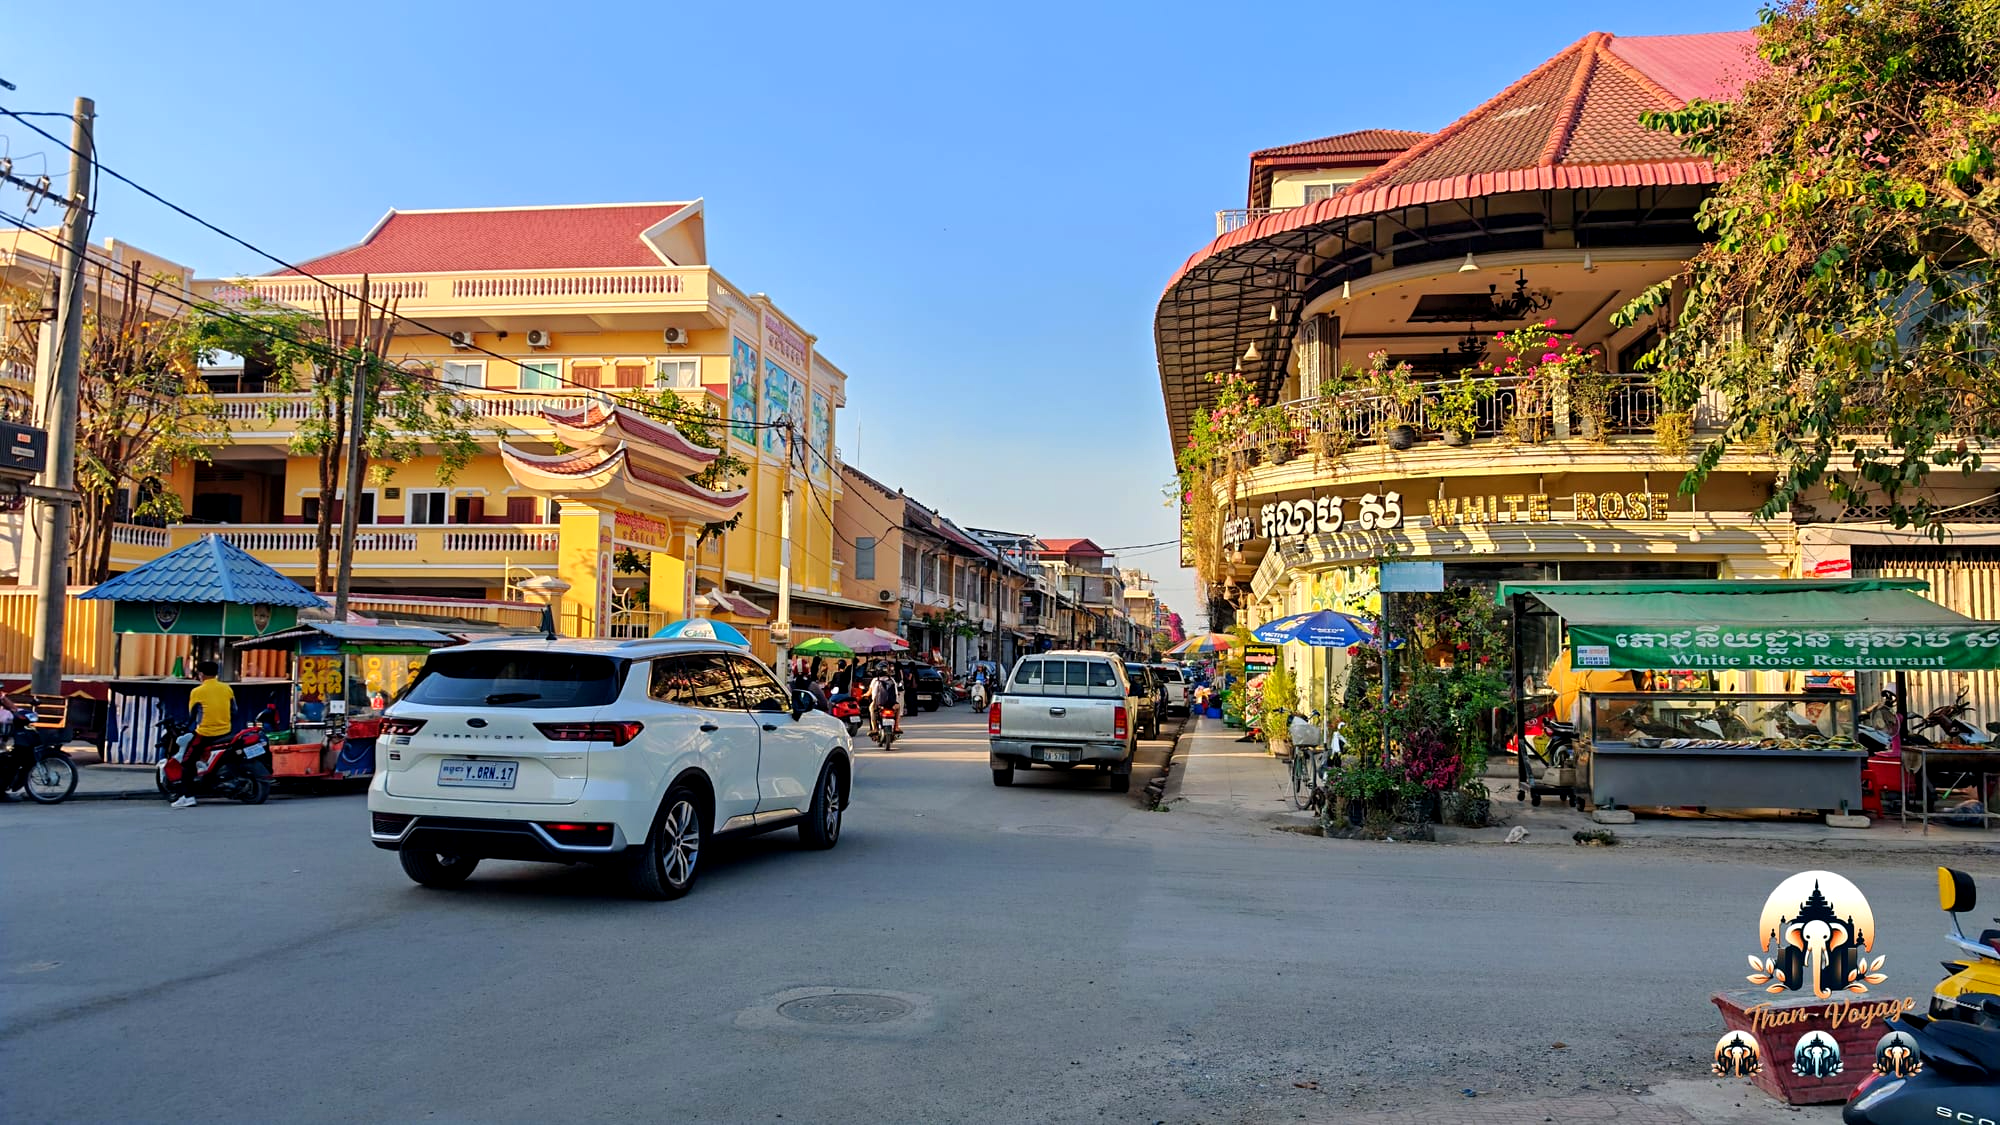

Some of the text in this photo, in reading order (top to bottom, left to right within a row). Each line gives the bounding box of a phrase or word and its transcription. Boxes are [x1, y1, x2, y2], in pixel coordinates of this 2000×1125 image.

[1427, 491, 1669, 526] WHITE ROSE
[1844, 631, 1950, 655] កុលាប
[1669, 654, 1947, 666] White Rose Restaurant
